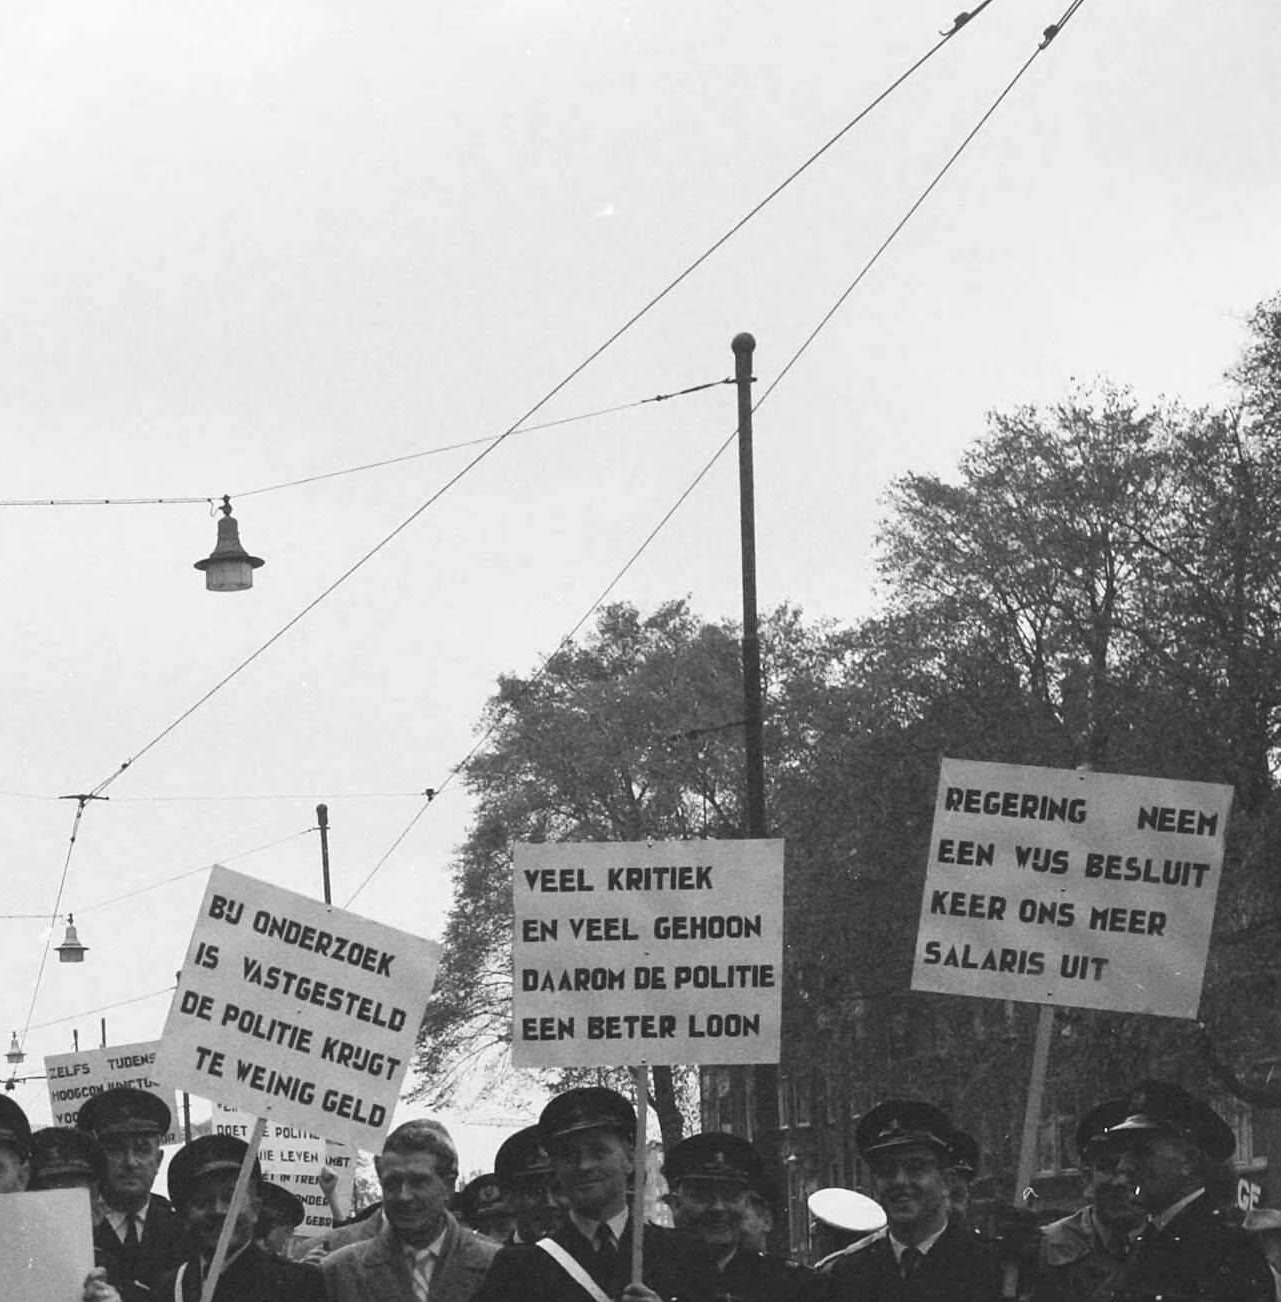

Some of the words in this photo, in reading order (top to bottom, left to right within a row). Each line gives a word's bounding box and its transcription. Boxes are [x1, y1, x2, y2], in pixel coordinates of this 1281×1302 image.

[945, 787, 1087, 824] REGERING
[1137, 806, 1218, 837] NEEM
[523, 869, 594, 893] VEEL
[608, 866, 713, 891] KRITIEK
[937, 839, 995, 867] EEN
[1085, 852, 1210, 888] BESLUIT
[522, 918, 558, 942] EN
[569, 917, 639, 942] VEEL
[654, 915, 762, 940] GEHOON
[931, 890, 1007, 921] KEER
[1019, 899, 1074, 927] ONS
[1089, 906, 1166, 936] MEER
[253, 911, 395, 977] ONDERZOEK
[924, 941, 1045, 975] SALARIS
[1060, 954, 1109, 981] UIT
[195, 942, 219, 970] IS
[244, 957, 406, 1032] VASTGESTELD
[522, 968, 625, 992] DAAROM
[634, 966, 667, 990] DE
[674, 964, 775, 990] POLITIE
[180, 990, 215, 1021] DE
[221, 1003, 313, 1054] POLITIE
[522, 1017, 575, 1041] EEN
[587, 1015, 676, 1040] BETER
[688, 1014, 759, 1038] LOON
[49, 1063, 90, 1079] ZELFS
[196, 1046, 226, 1078] TE
[237, 1059, 315, 1105] WEINIG
[322, 1089, 386, 1128] GELD
[57, 1112, 79, 1124] VOO
